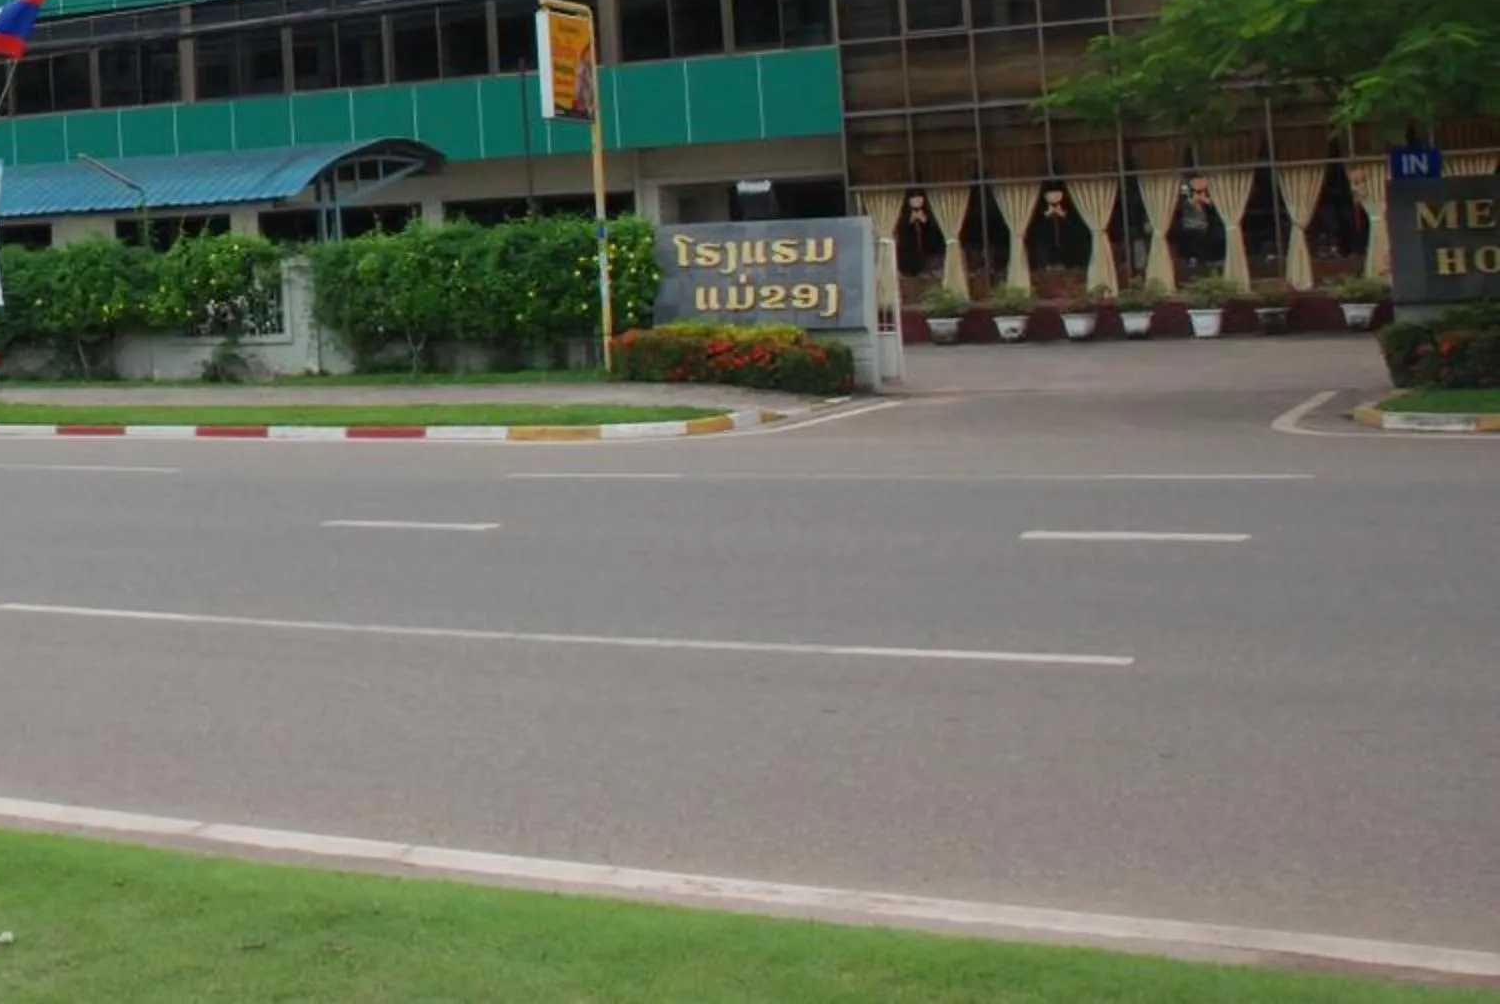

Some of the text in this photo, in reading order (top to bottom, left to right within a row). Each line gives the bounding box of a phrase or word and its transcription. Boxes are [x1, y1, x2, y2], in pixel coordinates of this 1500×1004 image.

[1402, 153, 1429, 175] IN
[1415, 199, 1496, 229] ME
[672, 234, 834, 275] ໂຮງແຮມ
[1435, 246, 1500, 275] HO
